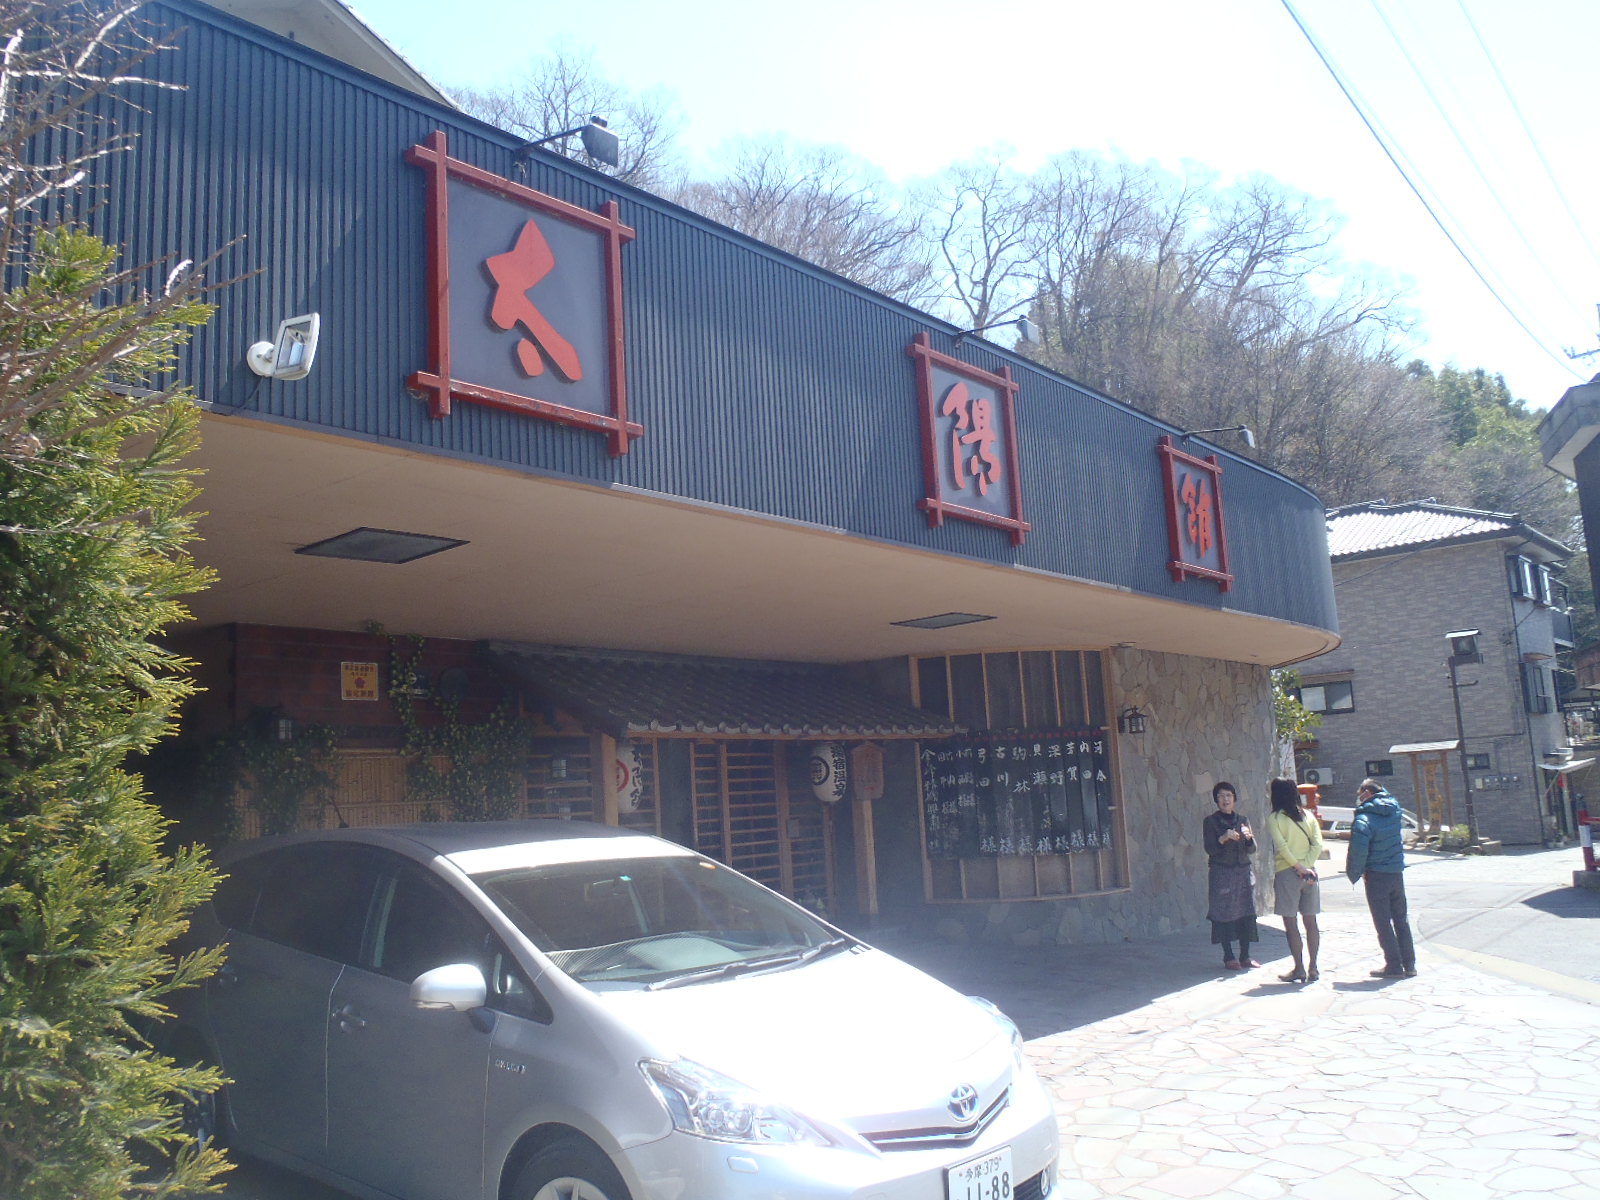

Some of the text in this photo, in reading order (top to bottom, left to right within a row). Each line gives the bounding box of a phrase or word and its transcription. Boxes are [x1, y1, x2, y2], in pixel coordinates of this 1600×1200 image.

[484, 218, 584, 382] 太
[966, 1157, 1000, 1182] 多摩 379
